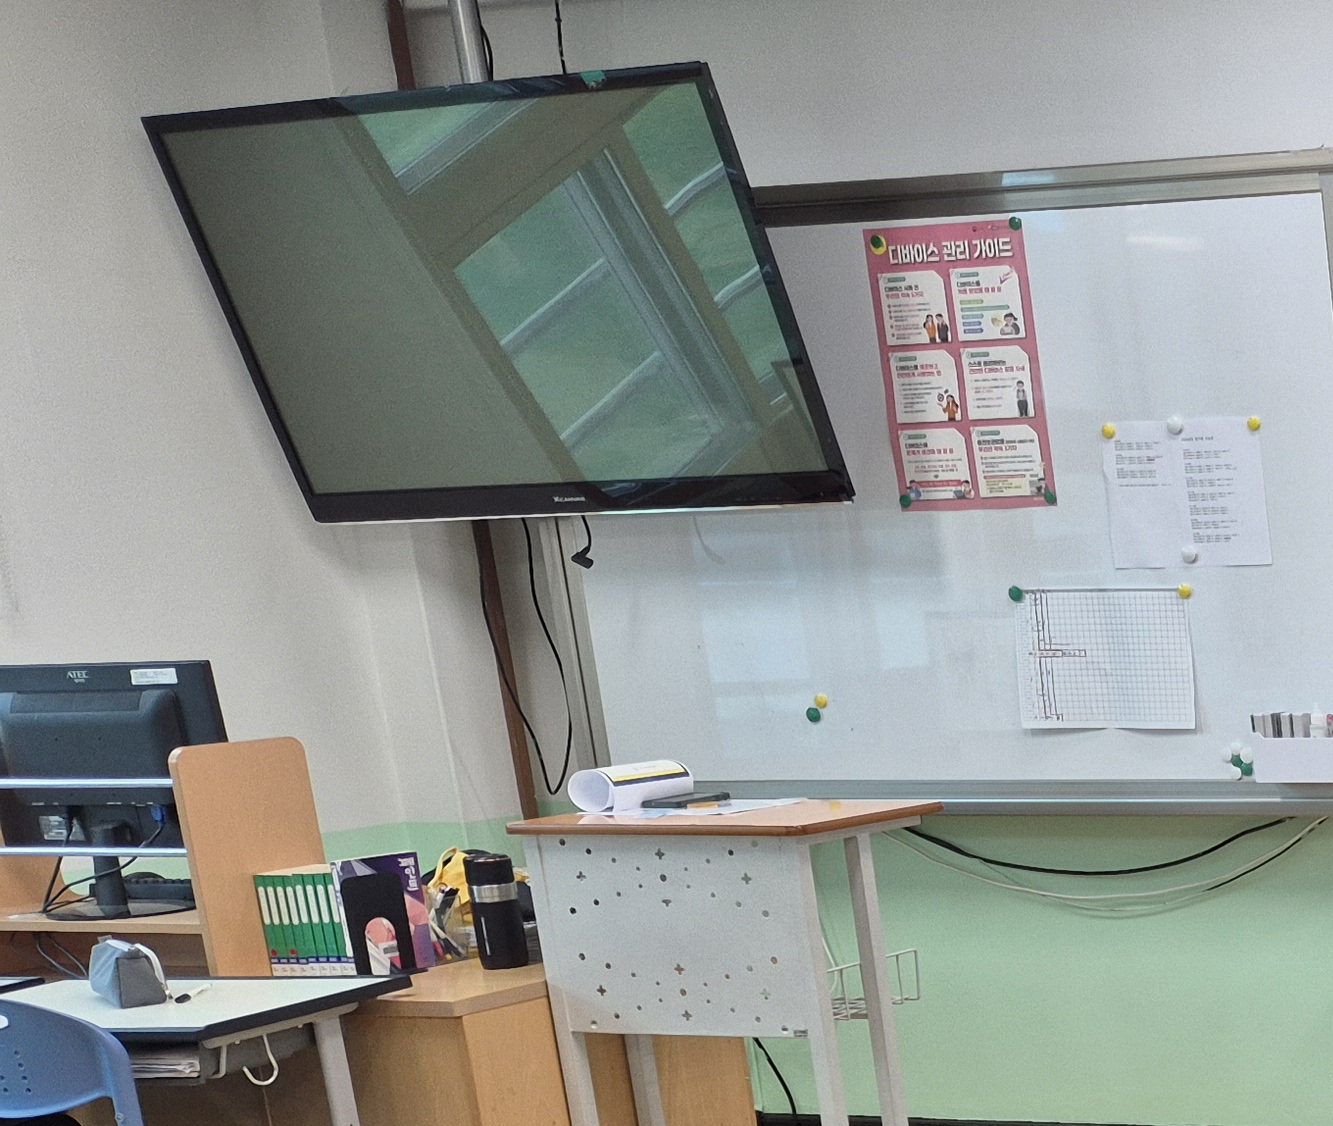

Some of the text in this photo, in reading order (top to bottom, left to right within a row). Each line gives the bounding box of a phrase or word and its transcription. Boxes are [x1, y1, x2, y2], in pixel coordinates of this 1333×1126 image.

[888, 237, 1014, 265] 디바이스 관리 가이드
